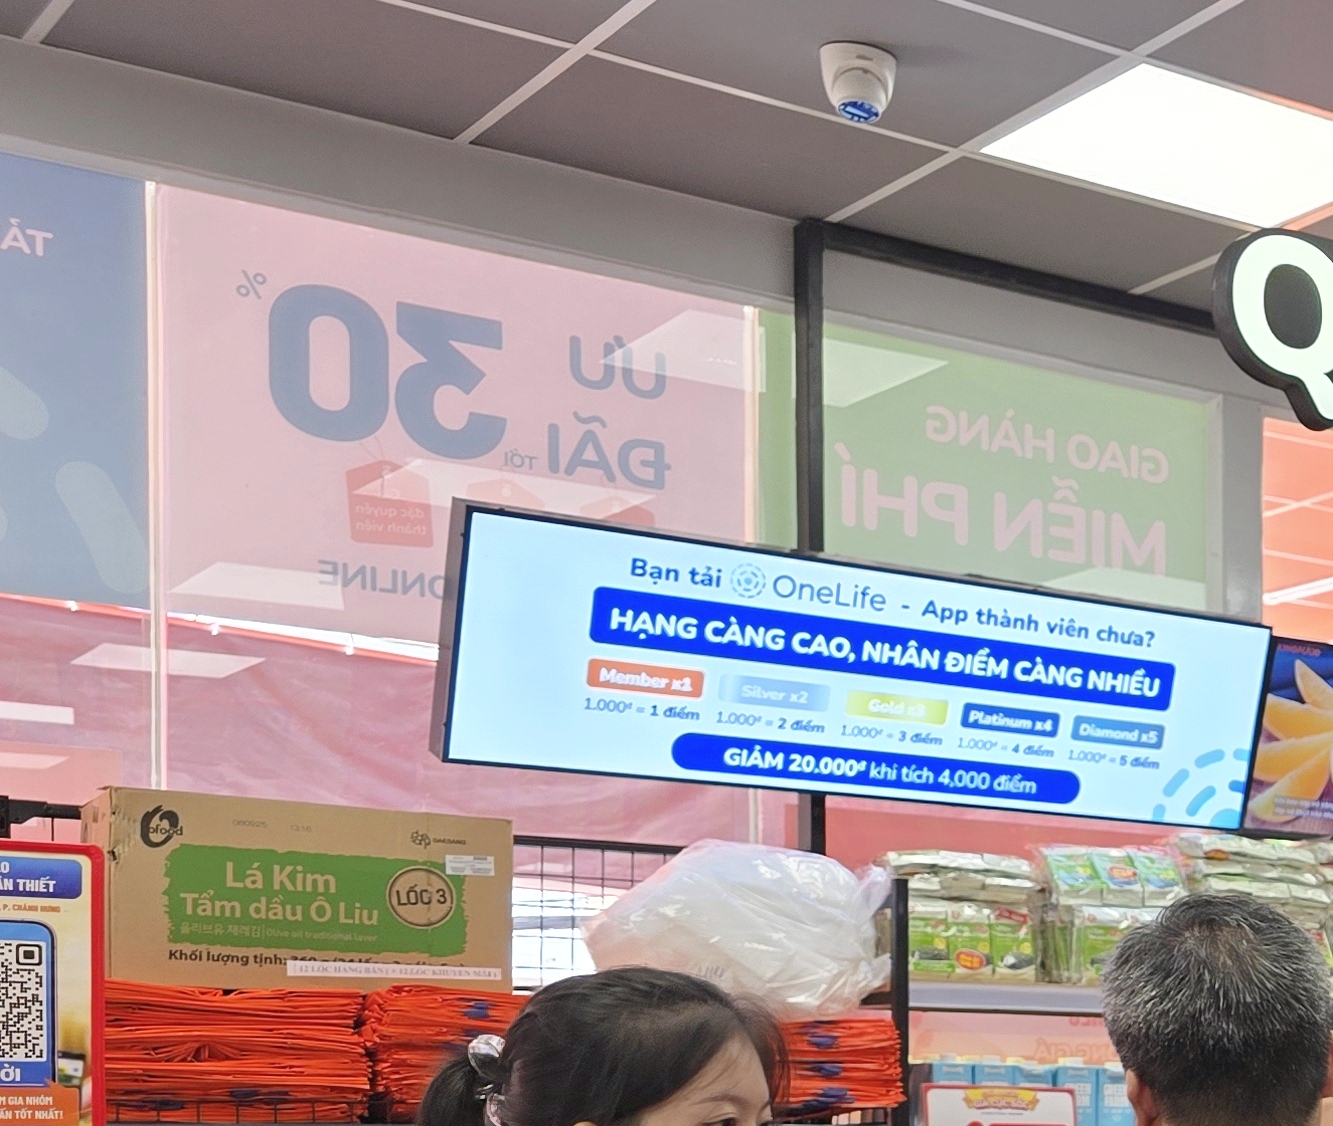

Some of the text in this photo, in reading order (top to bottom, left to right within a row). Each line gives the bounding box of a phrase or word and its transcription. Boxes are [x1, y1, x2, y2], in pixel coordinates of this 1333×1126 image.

[630, 557, 1156, 648] Bạn tải OneLife App thành viên chưa?
[609, 607, 1161, 698] HẠNG CÀNG CAO, NHÂN ĐIỂM CÀNG NHIỀU
[598, 667, 670, 689] Member
[741, 684, 809, 704] Silver x2
[867, 698, 905, 716] Gold
[967, 709, 1032, 731] Platinum
[1078, 721, 1160, 745] Diamond x5
[723, 745, 784, 771] GIẢM
[869, 761, 898, 782] khi
[900, 763, 934, 785] tích
[992, 772, 1038, 798] điểm
[16, 876, 56, 894] THIẾT
[225, 861, 337, 893] Lá Kim
[180, 890, 379, 925] Tẩm dầu Ô Liu
[436, 888, 448, 905] 3
[168, 948, 287, 967] Khối lượng tịnh:
[8, 1094, 53, 1107] GIA NHÓM
[14, 1106, 33, 1120] TỐT
